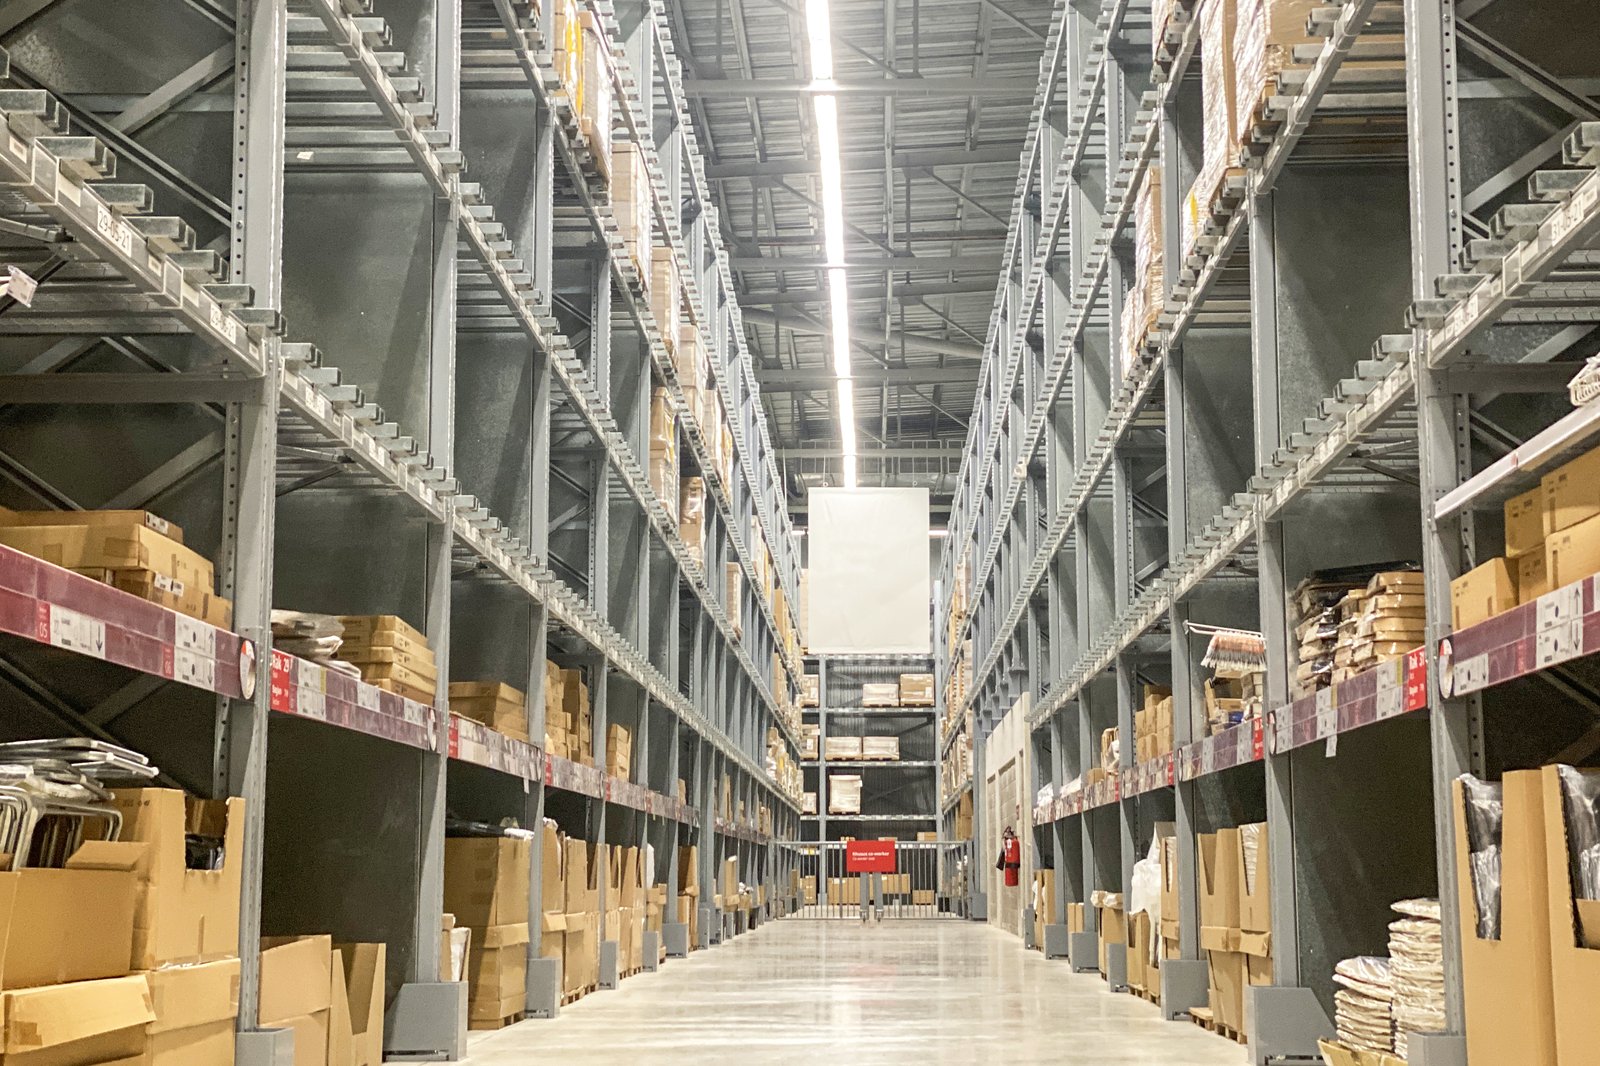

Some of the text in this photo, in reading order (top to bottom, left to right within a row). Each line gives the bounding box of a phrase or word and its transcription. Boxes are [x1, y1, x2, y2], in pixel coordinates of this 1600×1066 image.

[98, 209, 131, 252] 29-05-21
[39, 621, 48, 639] 05
[272, 653, 290, 673] Rak 29
